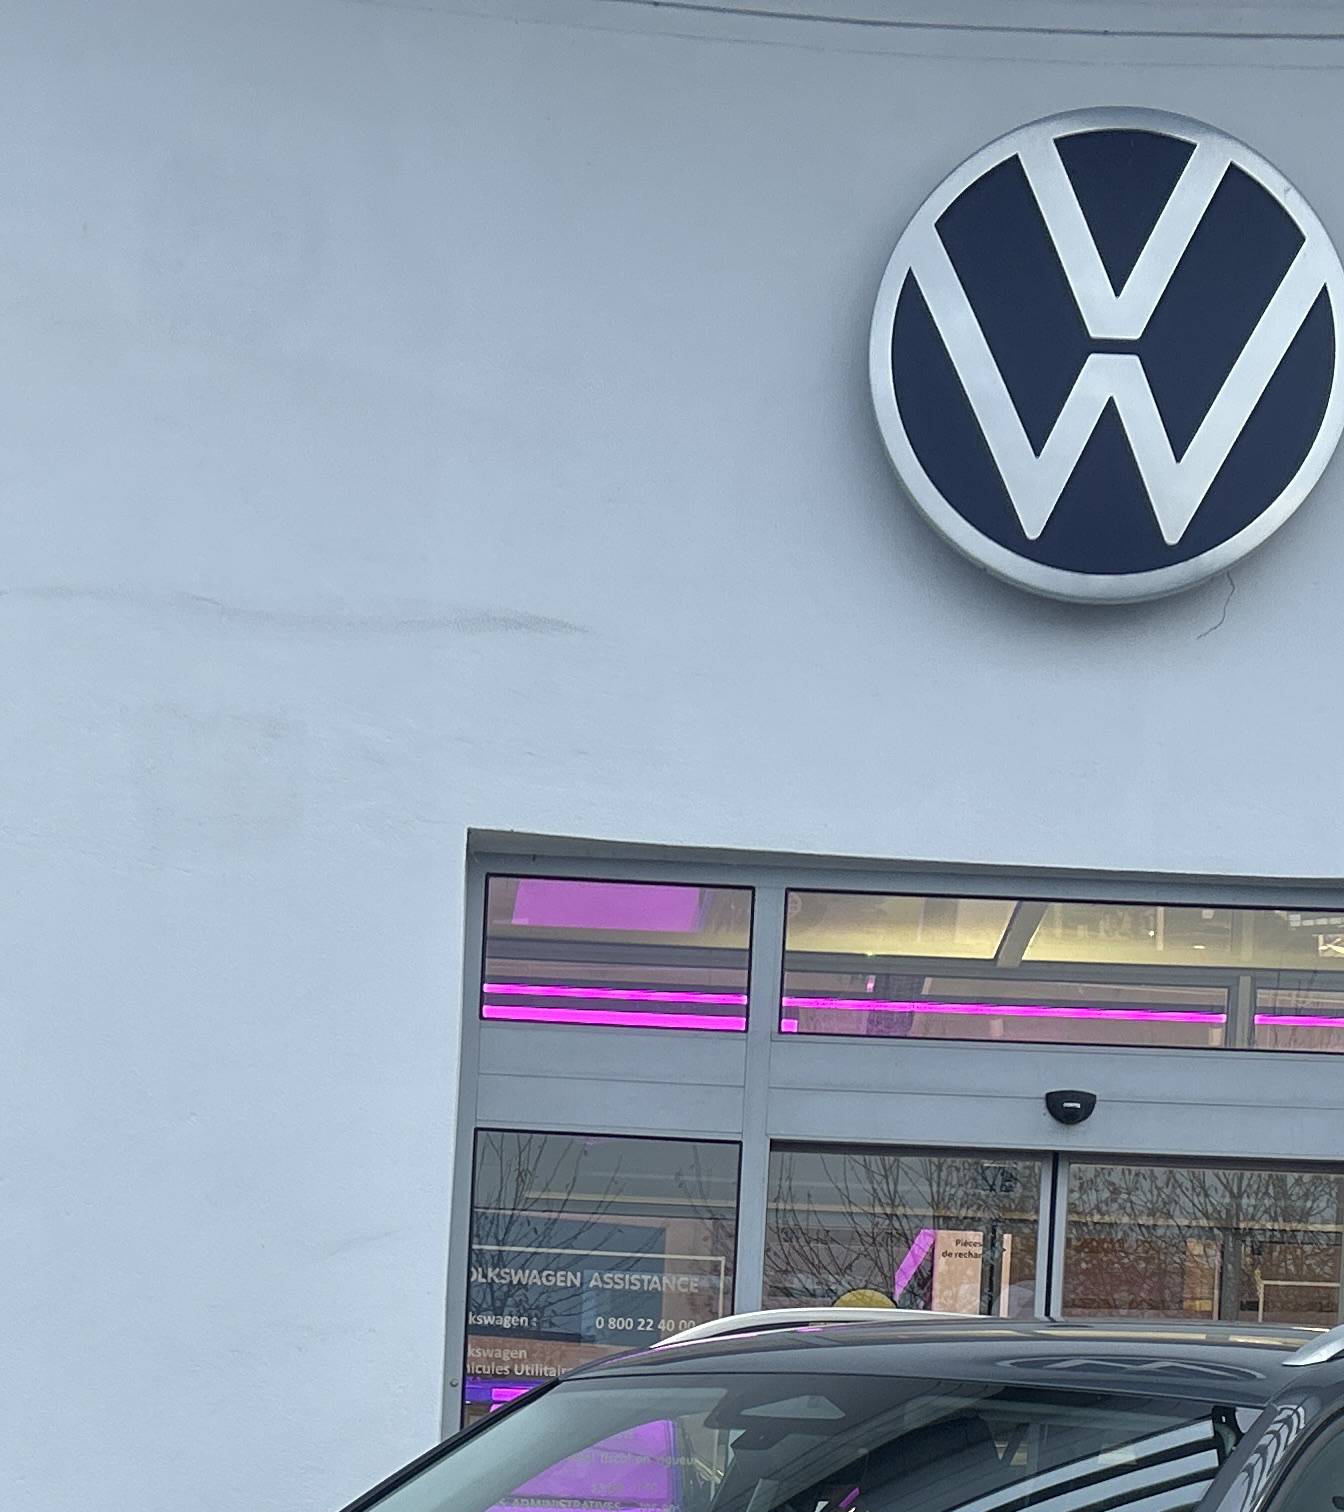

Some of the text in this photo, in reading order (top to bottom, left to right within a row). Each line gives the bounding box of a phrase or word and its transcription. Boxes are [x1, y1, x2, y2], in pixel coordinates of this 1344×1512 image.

[470, 1267, 699, 1293] LKSWAGEN ASSISTANCE
[468, 1311, 529, 1328] kswagen
[595, 1316, 605, 1329] 0
[607, 1317, 634, 1330] 800
[637, 1318, 654, 1331] 22
[657, 1319, 675, 1332] 40
[467, 1344, 528, 1361] kswagen
